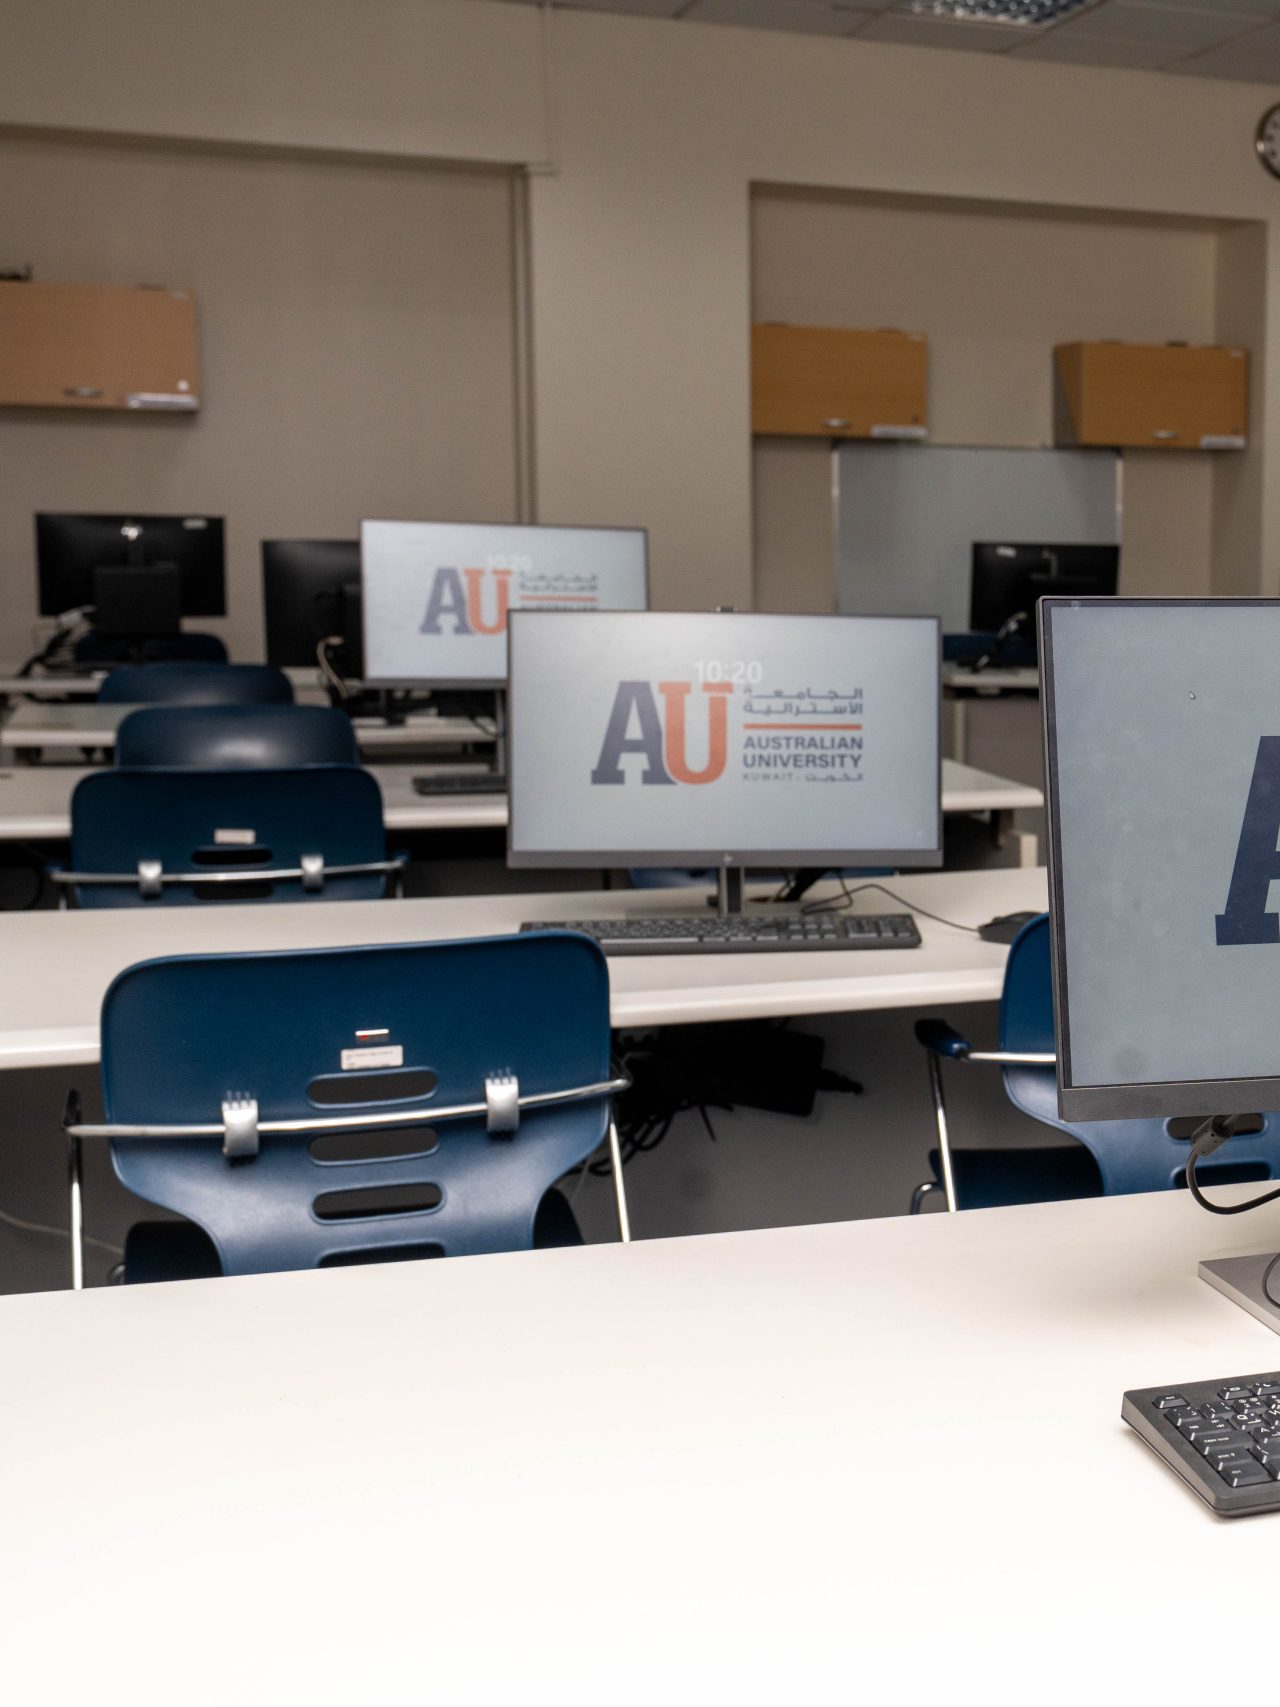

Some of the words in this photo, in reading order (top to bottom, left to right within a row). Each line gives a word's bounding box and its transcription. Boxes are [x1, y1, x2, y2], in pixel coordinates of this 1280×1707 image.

[694, 661, 763, 684] 10:20
[591, 680, 734, 786] AU
[743, 736, 863, 750] AUSTRALIAN
[743, 754, 863, 769] UNIVERSITY
[743, 772, 795, 782] KUWAIT
